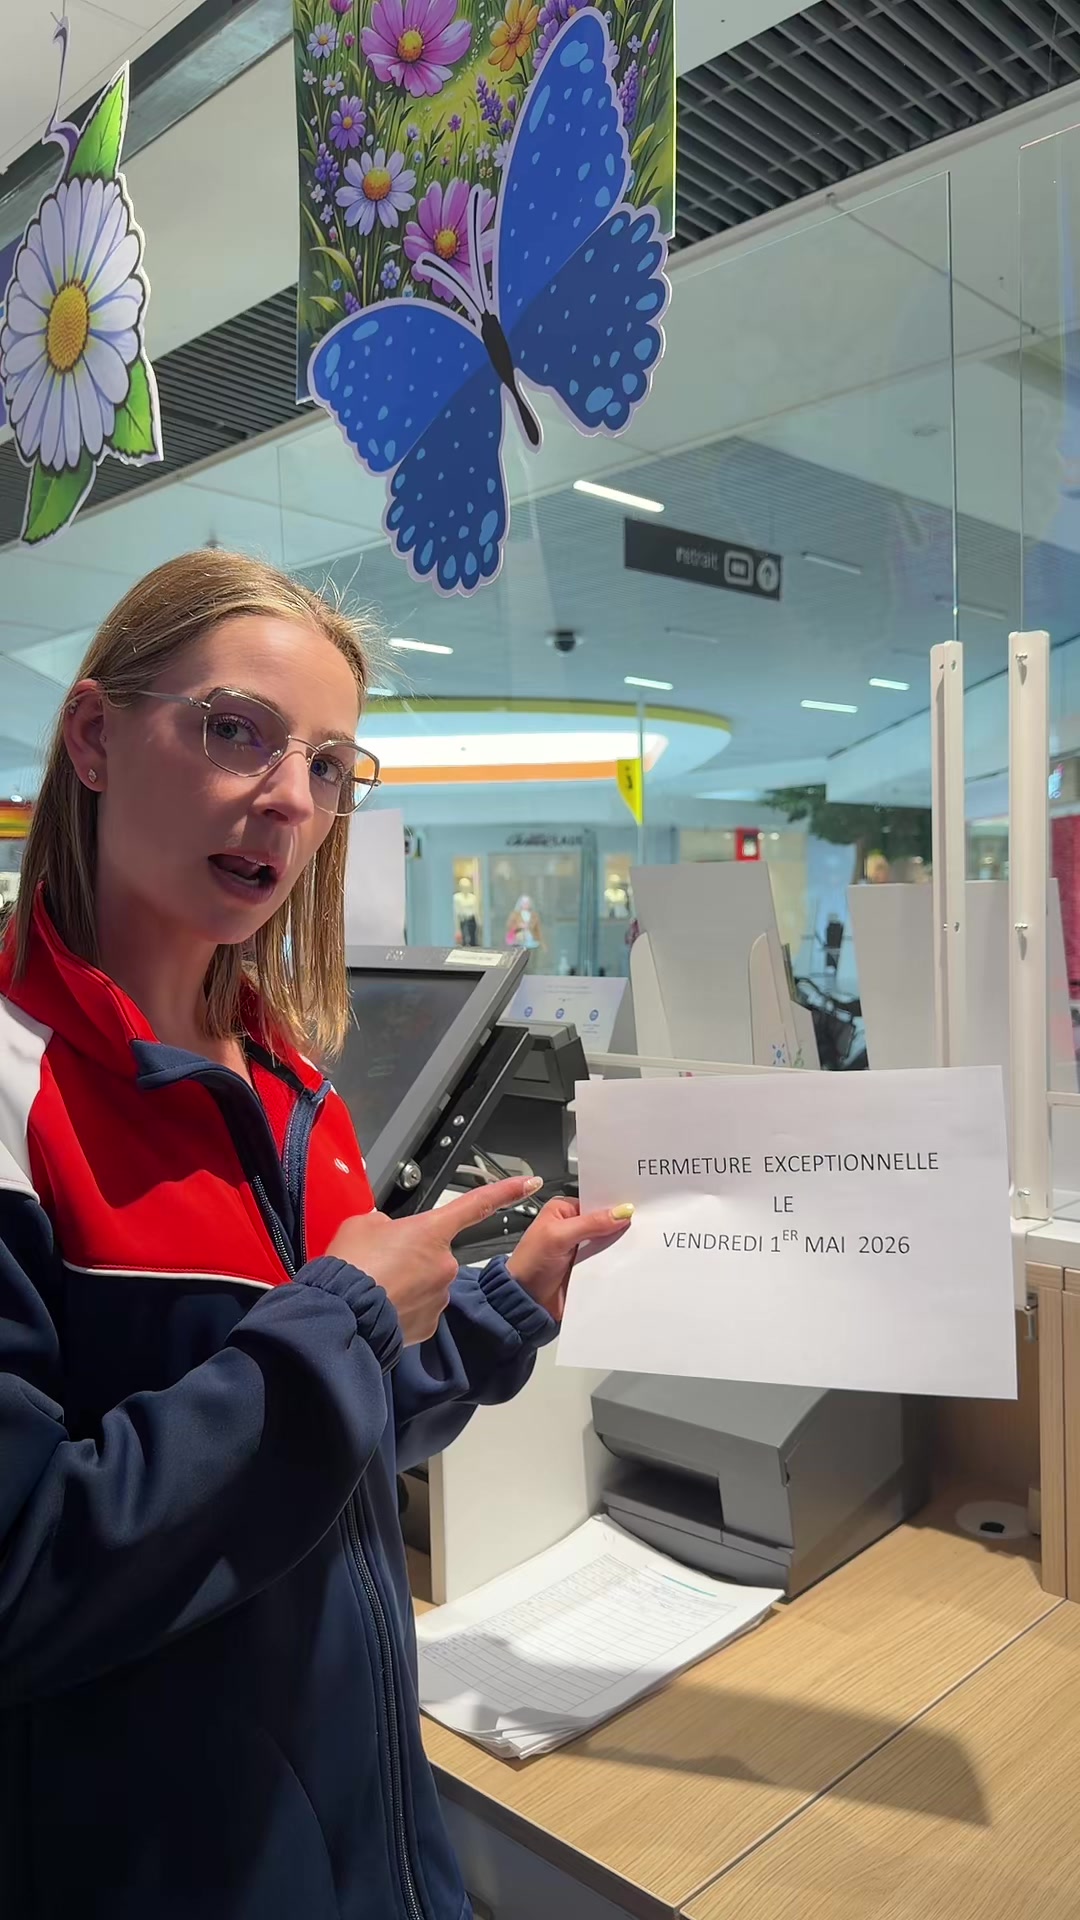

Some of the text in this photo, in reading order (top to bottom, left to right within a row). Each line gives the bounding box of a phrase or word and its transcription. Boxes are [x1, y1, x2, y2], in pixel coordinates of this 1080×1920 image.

[637, 1151, 939, 1176] FERMETURE EXCEPTIONNELLE
[773, 1195, 794, 1213] LE
[663, 1231, 763, 1253] VENDREDI
[805, 1235, 845, 1254] MAI
[858, 1235, 911, 1255] 2026
